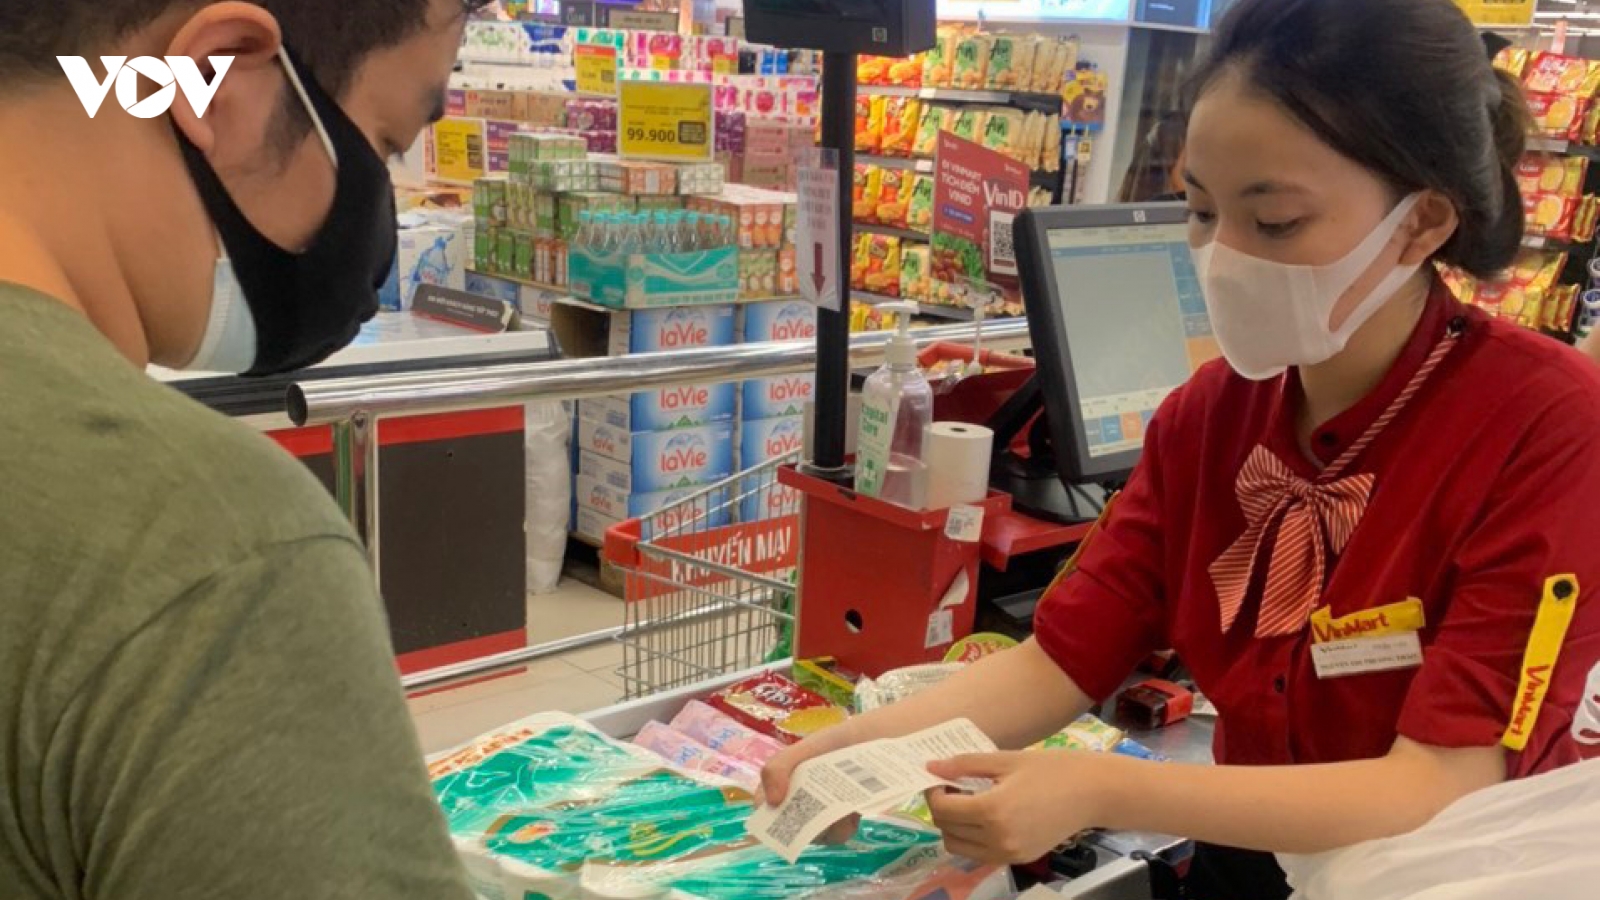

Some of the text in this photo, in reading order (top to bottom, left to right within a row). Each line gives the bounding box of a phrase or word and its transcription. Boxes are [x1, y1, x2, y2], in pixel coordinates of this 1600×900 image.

[627, 126, 676, 143] 99.900
[983, 179, 1024, 210] VinID
[660, 322, 708, 347] laVie
[771, 319, 814, 341] laVie
[660, 385, 708, 409] laVie
[770, 378, 812, 400] laVie
[660, 447, 707, 472] laVie
[1312, 612, 1389, 642] VinMart
[1510, 664, 1550, 735] VinMart
